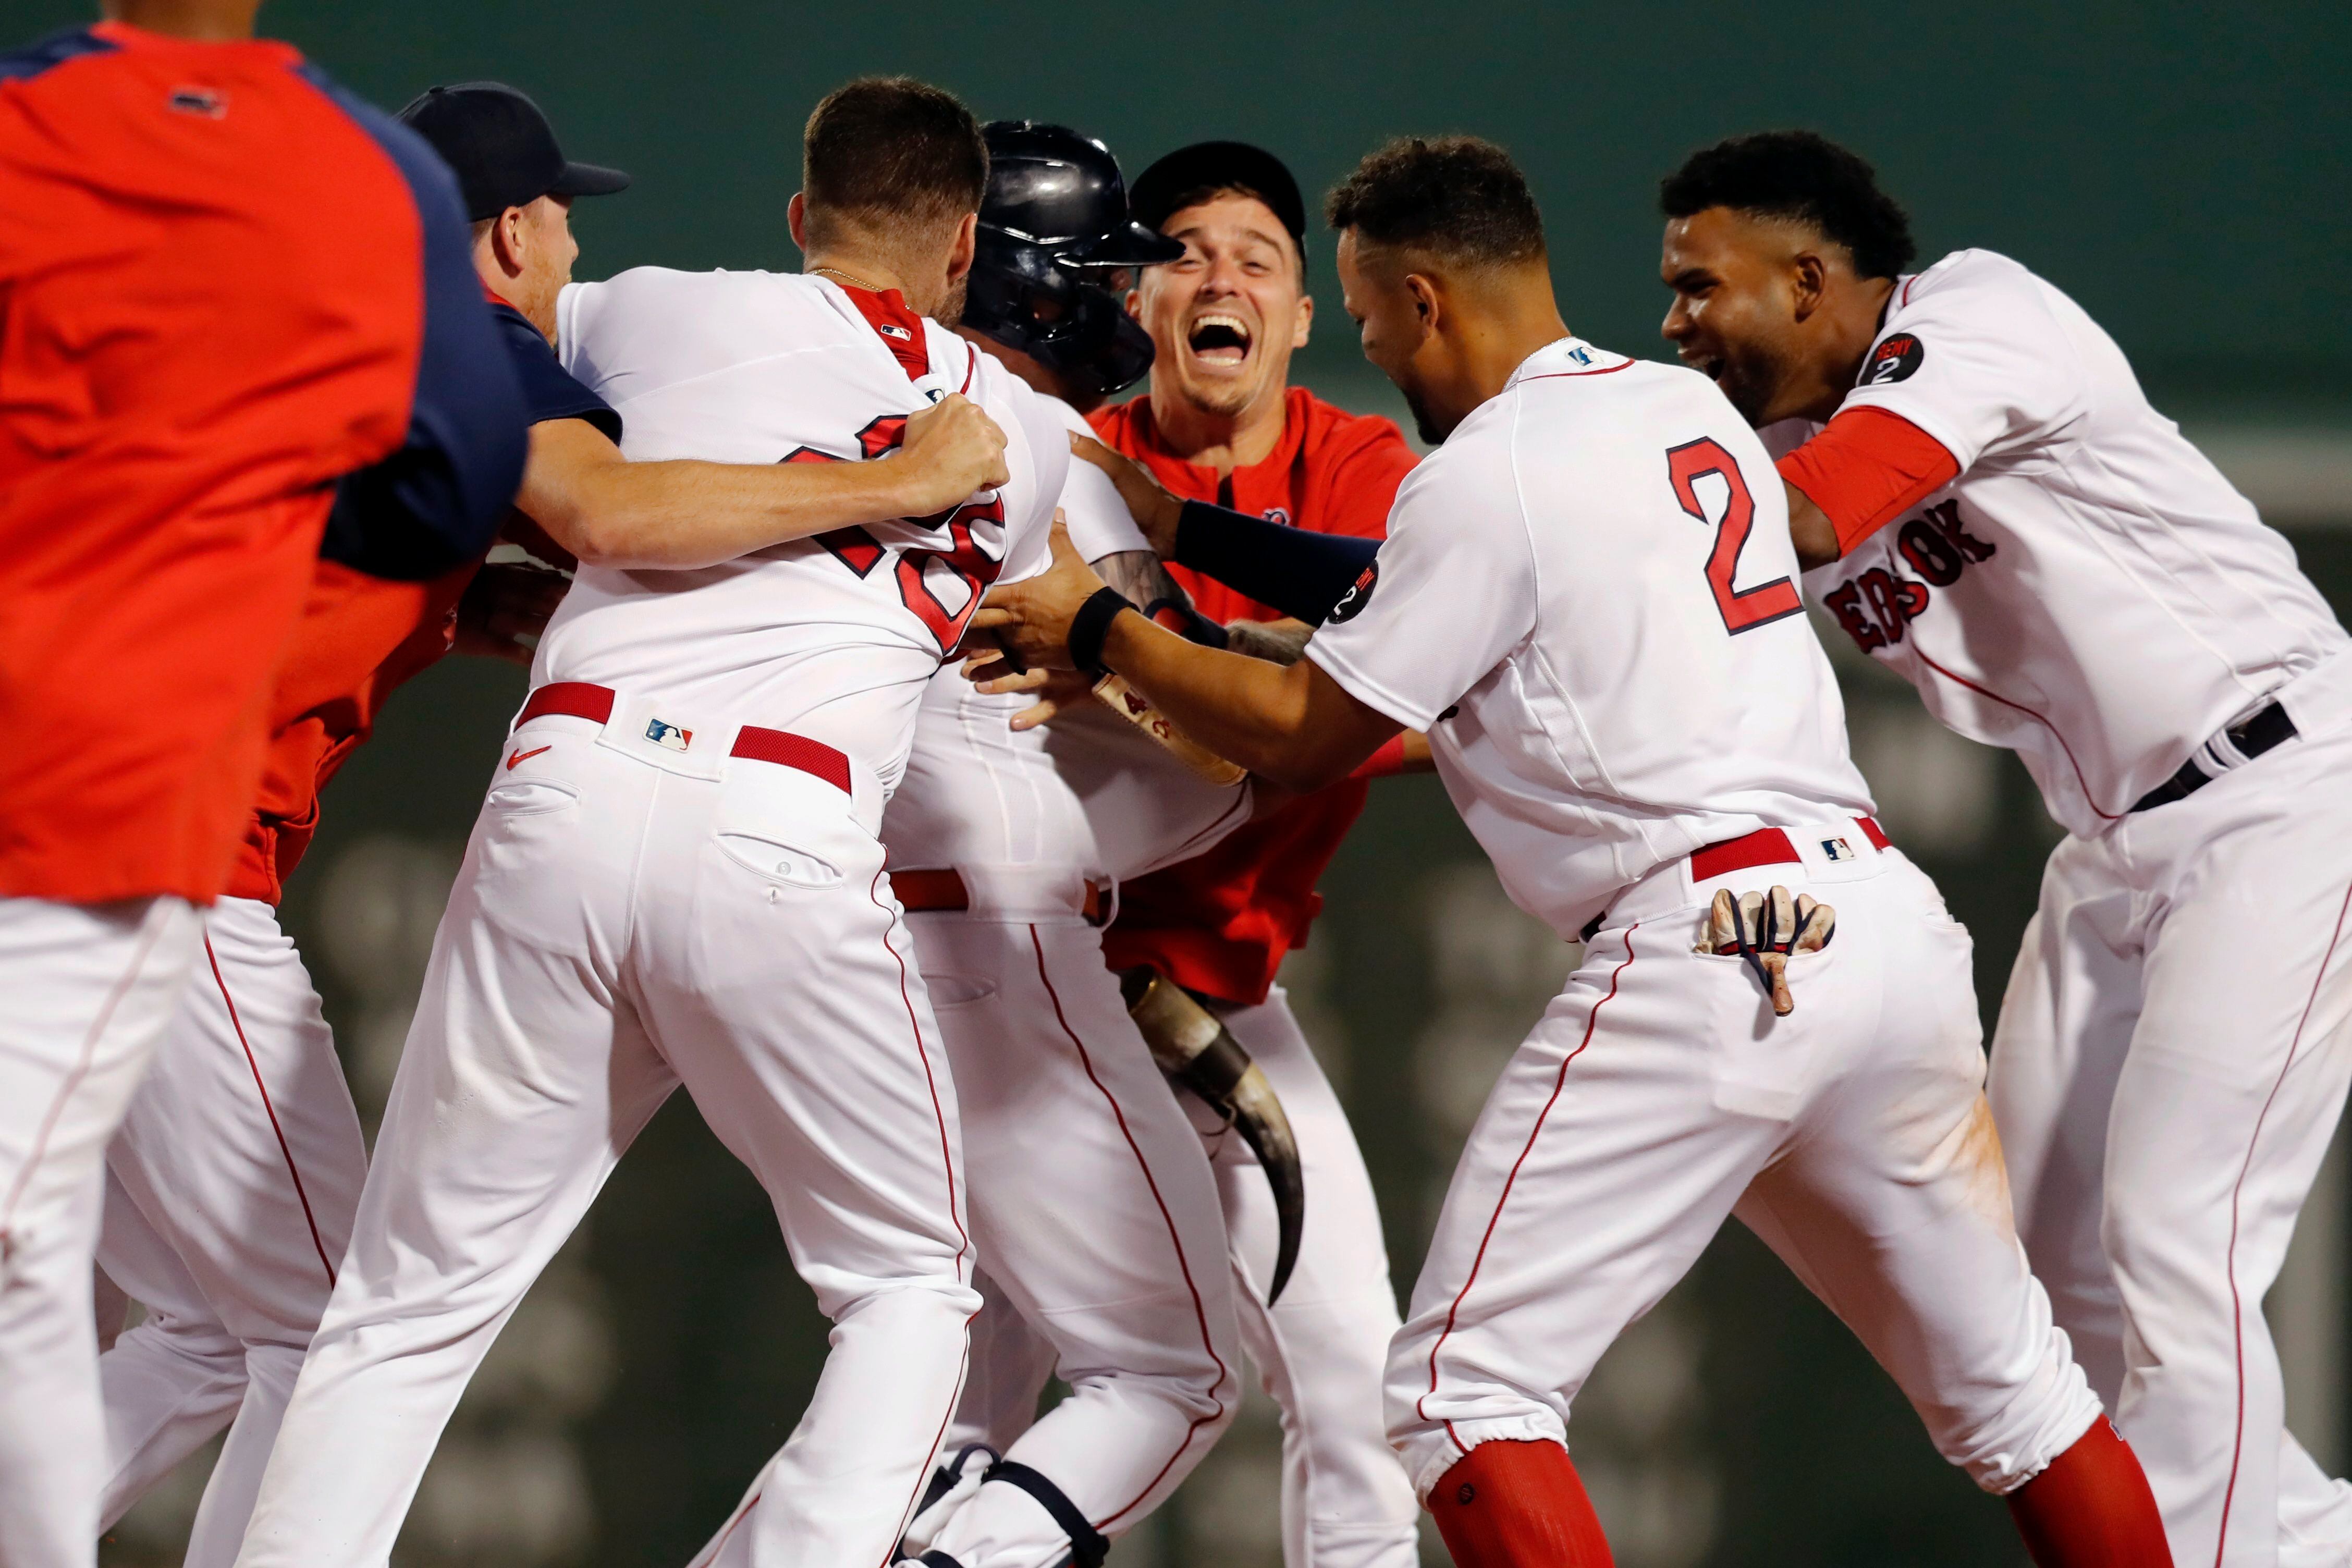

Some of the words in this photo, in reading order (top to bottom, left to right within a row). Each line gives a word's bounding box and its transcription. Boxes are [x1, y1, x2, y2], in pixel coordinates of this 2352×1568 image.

[1870, 357, 1900, 385] 2
[1665, 436, 1806, 636] 2
[1333, 585, 1357, 616] 2
